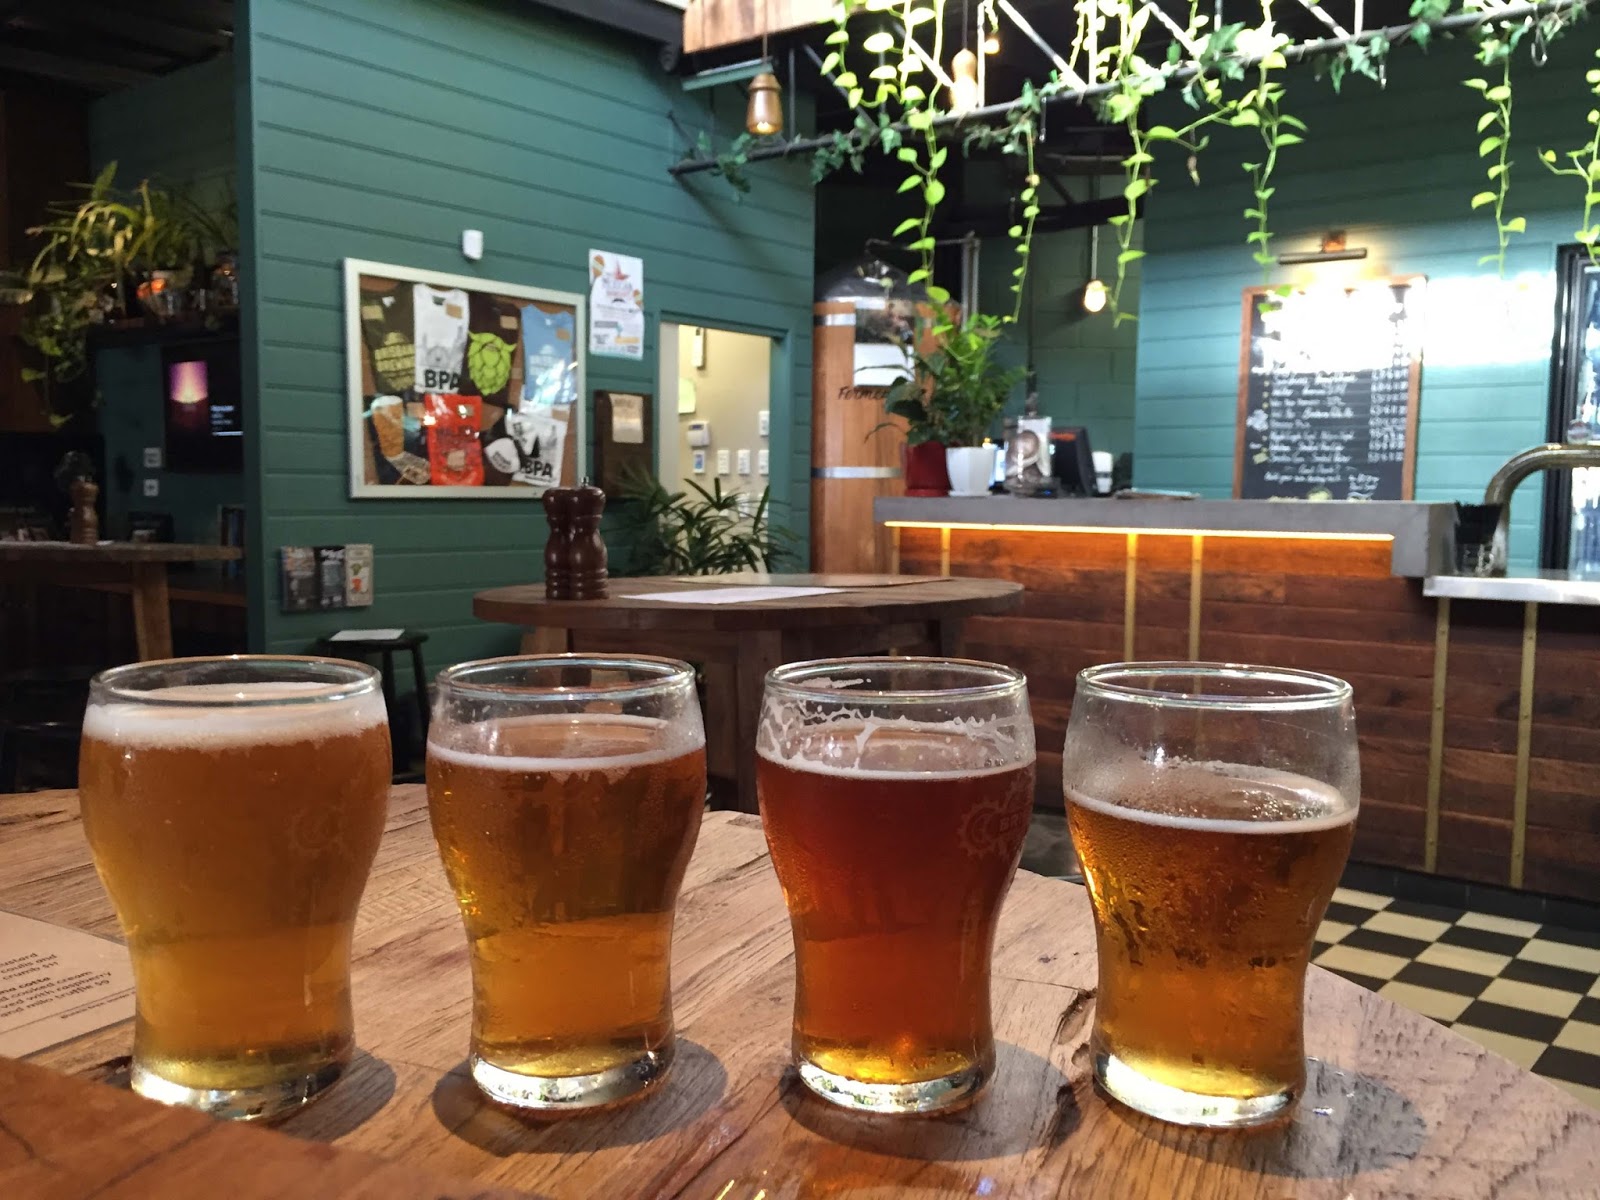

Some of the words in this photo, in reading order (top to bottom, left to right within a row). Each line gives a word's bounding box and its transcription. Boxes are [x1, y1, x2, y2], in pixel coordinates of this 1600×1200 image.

[36, 954, 57, 964] and
[11, 982, 55, 998] cooked
[57, 971, 93, 984] cream
[19, 977, 51, 988] cotta
[26, 990, 55, 1001] with
[57, 972, 111, 991] raspberry
[1, 1007, 24, 1018] and
[55, 984, 94, 999] truffle
